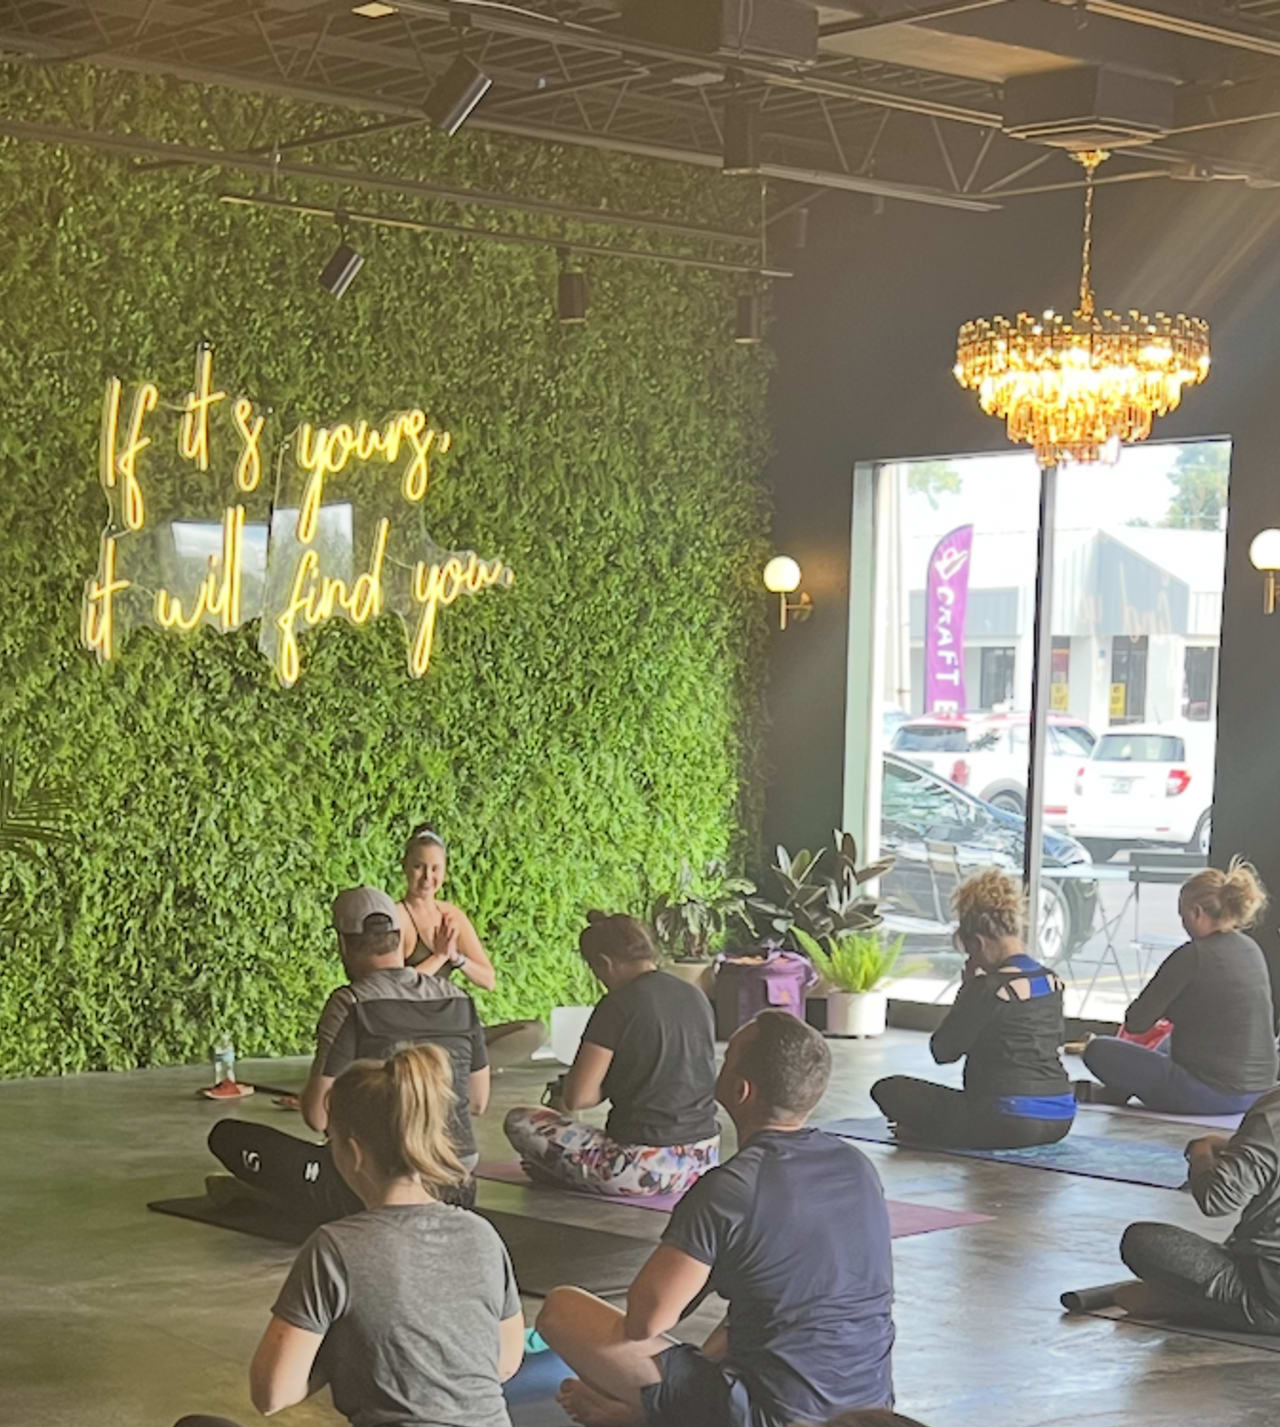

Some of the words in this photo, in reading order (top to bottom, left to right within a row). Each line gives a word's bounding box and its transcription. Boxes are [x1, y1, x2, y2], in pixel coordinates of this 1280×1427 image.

[104, 376, 158, 530] If
[86, 537, 131, 660] it
[157, 503, 246, 629] will
[277, 518, 389, 685] find
[935, 586, 960, 686] CRAFT
